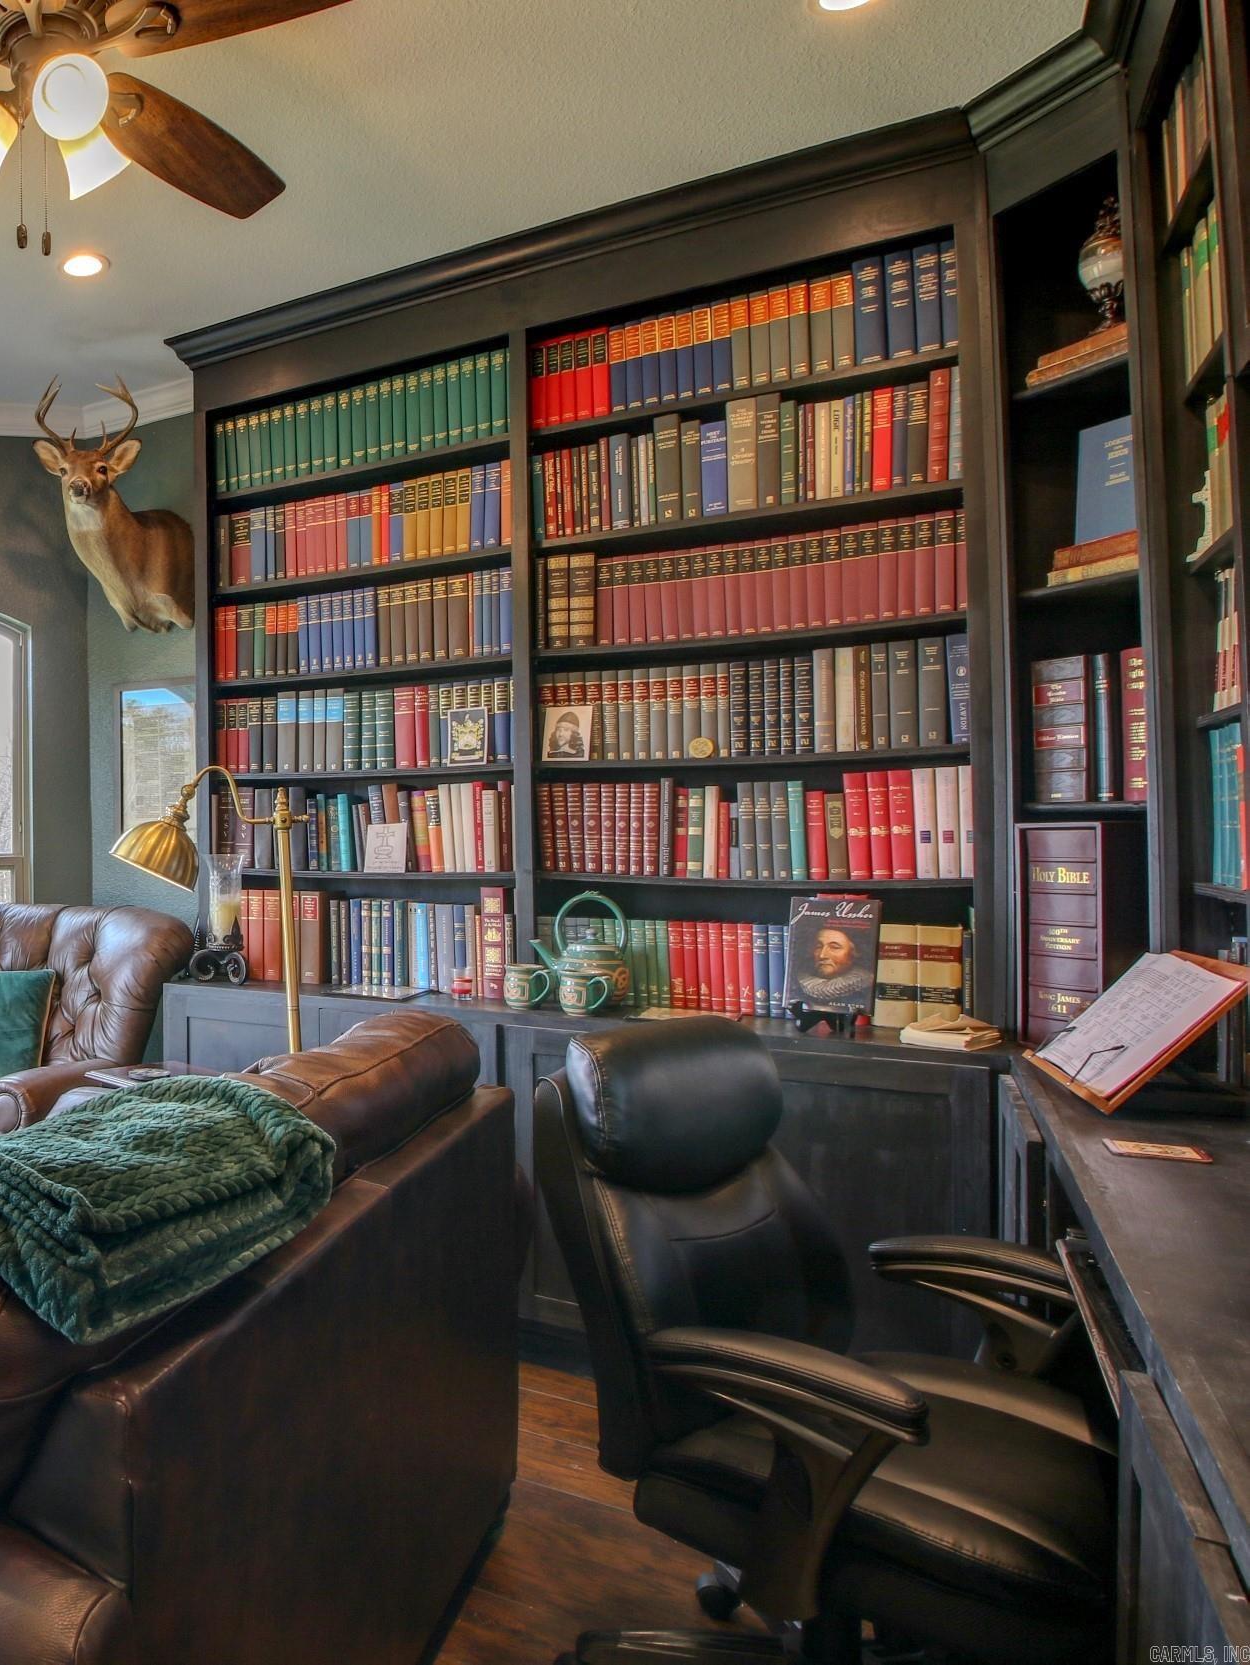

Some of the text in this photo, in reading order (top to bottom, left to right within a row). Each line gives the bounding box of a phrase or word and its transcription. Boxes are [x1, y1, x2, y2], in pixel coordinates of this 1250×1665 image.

[1032, 866, 1090, 884] HOLY BIBLE
[790, 902, 831, 925] James
[1045, 943, 1072, 952] EDITION
[1056, 993, 1081, 1004] JAMES
